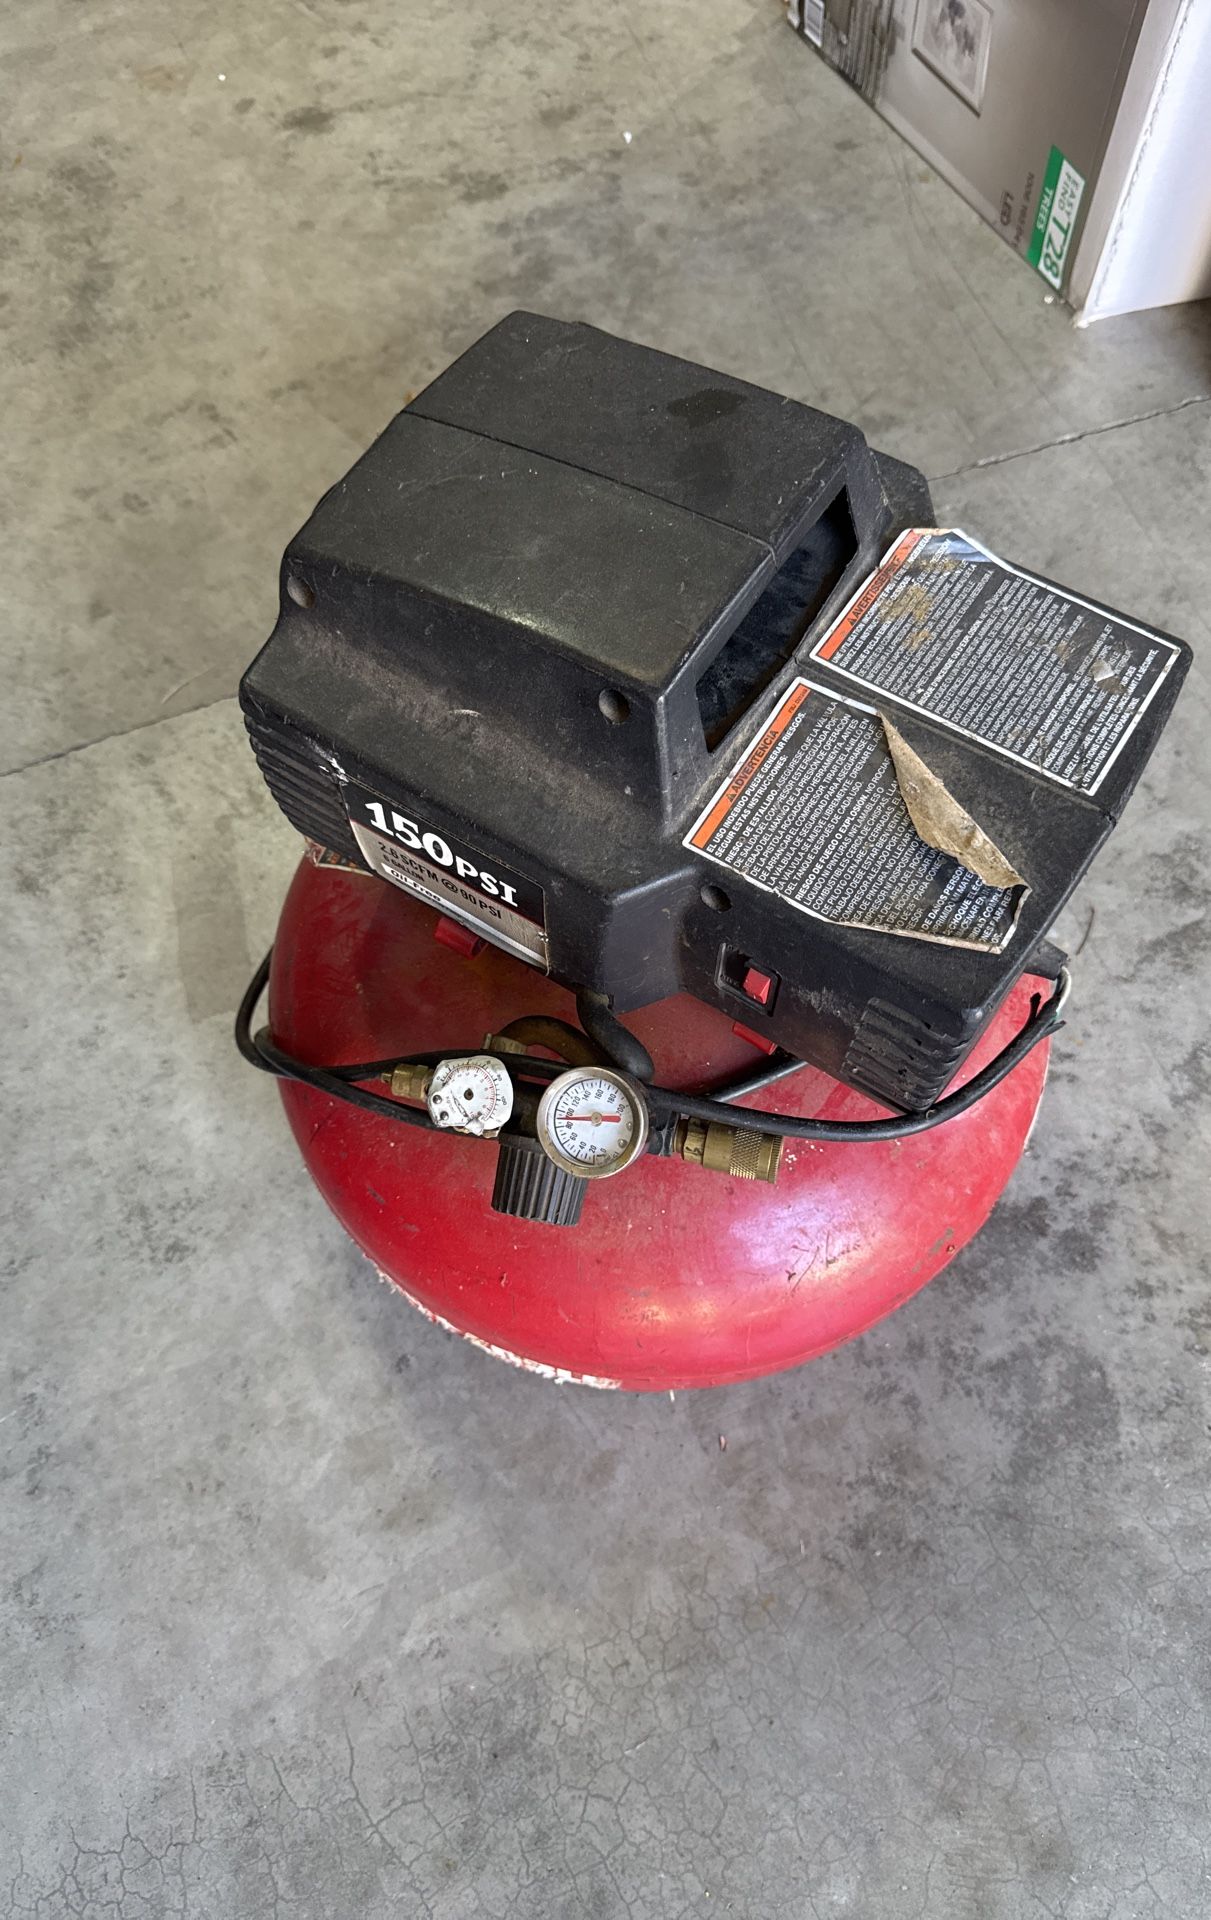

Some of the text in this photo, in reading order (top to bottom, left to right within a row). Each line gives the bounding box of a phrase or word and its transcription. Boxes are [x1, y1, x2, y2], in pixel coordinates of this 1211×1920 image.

[1036, 186, 1053, 233] TREES
[1058, 172, 1073, 211] FIND
[1065, 178, 1079, 217] EASY
[1043, 216, 1071, 279] T28
[852, 639, 864, 650] LES
[917, 650, 960, 706] RISQUE OU
[1022, 737, 1040, 758] RISQUE
[1039, 708, 1059, 731] DANGER
[1042, 724, 1074, 768] RISQUE DE CHOC
[1061, 725, 1099, 778] LISEZ DE
[1102, 731, 1118, 750] ET LES
[706, 842, 717, 852] EL
[712, 827, 727, 843] USO
[722, 794, 749, 829] INDEBIDO
[744, 772, 765, 796] PUEDE
[760, 741, 786, 773] GENERAR
[781, 710, 806, 742] RIESGOS.
[730, 728, 779, 793] ADVERTENCIA
[741, 825, 753, 837] DE
[748, 787, 779, 826] ESTALLIDO.
[799, 735, 814, 751] QUE
[808, 727, 819, 737] LA
[714, 753, 788, 857] SEGUIR ESTAS INSTRUCCIONES:
[733, 856, 745, 867] DE
[739, 832, 760, 858] SALIDA
[755, 820, 769, 834] DEL
[824, 716, 838, 730] POR
[749, 865, 761, 877] DE
[756, 856, 767, 867] LA
[762, 829, 785, 857] PISTOLA
[780, 791, 810, 830] ROCIADORA
[840, 717, 859, 740] ANTES
[758, 870, 769, 881] DE
[764, 833, 793, 871] ARRANCAR
[788, 825, 799, 835] EL
[822, 764, 839, 784] TIRAR
[834, 751, 848, 765] DEL
[858, 718, 870, 729] EN
[759, 831, 773, 846] DEL
[785, 794, 797, 806] DE
[792, 786, 803, 796] LA
[816, 749, 827, 760] DE
[863, 781, 875, 793] NO
[766, 875, 777, 886] LA
[772, 845, 797, 876] VÁLBULA
[792, 835, 803, 847] DE
[798, 798, 827, 837] SEGURIDAD
[822, 780, 839, 800] PARA
[834, 738, 867, 782] ASEGURARSE
[775, 741, 876, 891] LA VÁLVULA SE MUEVE DRENAR EL
[837, 791, 869, 833] EXPLOSIÓN.
[846, 791, 881, 838] INFLAMABLES
[784, 779, 863, 895] DEL TANQUE DESPUÉS DE CADA USO.
[817, 838, 839, 863] FUEGO
[825, 836, 852, 871] PINTURAS
[833, 832, 842, 840] O
[865, 849, 889, 881] ALEJADO
[884, 835, 898, 851] POR
[893, 824, 905, 837] LO
[400, 853, 439, 883] SCFM
[460, 888, 476, 905] 90
[479, 901, 501, 919] PSI
[793, 872, 816, 901] RIESGO
[810, 861, 823, 874] DE
[811, 857, 850, 910] COMBUSTIBLES
[845, 835, 864, 859] CERCA
[859, 824, 871, 836] DE
[820, 868, 831, 878] NI
[829, 887, 854, 919] TRABAJO
[848, 868, 866, 888] DEBE
[860, 846, 880, 870] ESTAR
[874, 830, 890, 848] BIEN
[859, 899, 870, 910] DE
[885, 857, 896, 869] NO
[891, 832, 912, 859] LLEVAR
[883, 882, 892, 890] NI
[888, 839, 919, 882] DISPOSITIVO
[802, 876, 826, 906] LÍQUIDO
[820, 903, 832, 915] DE
[827, 878, 848, 905] PILOTO
[846, 863, 858, 874] EN
[880, 868, 913, 914] DEL DEL
[886, 857, 931, 923] DEL USAR
[900, 909, 911, 920] DE
[912, 880, 929, 900] PARA
[921, 918, 932, 930] DE
[572, 1096, 581, 1107] 120
[595, 1089, 604, 1100] 160
[607, 1093, 617, 1104] 180
[570, 1132, 578, 1141] 60
[579, 1141, 587, 1150] 40
[589, 1144, 597, 1154] 20
